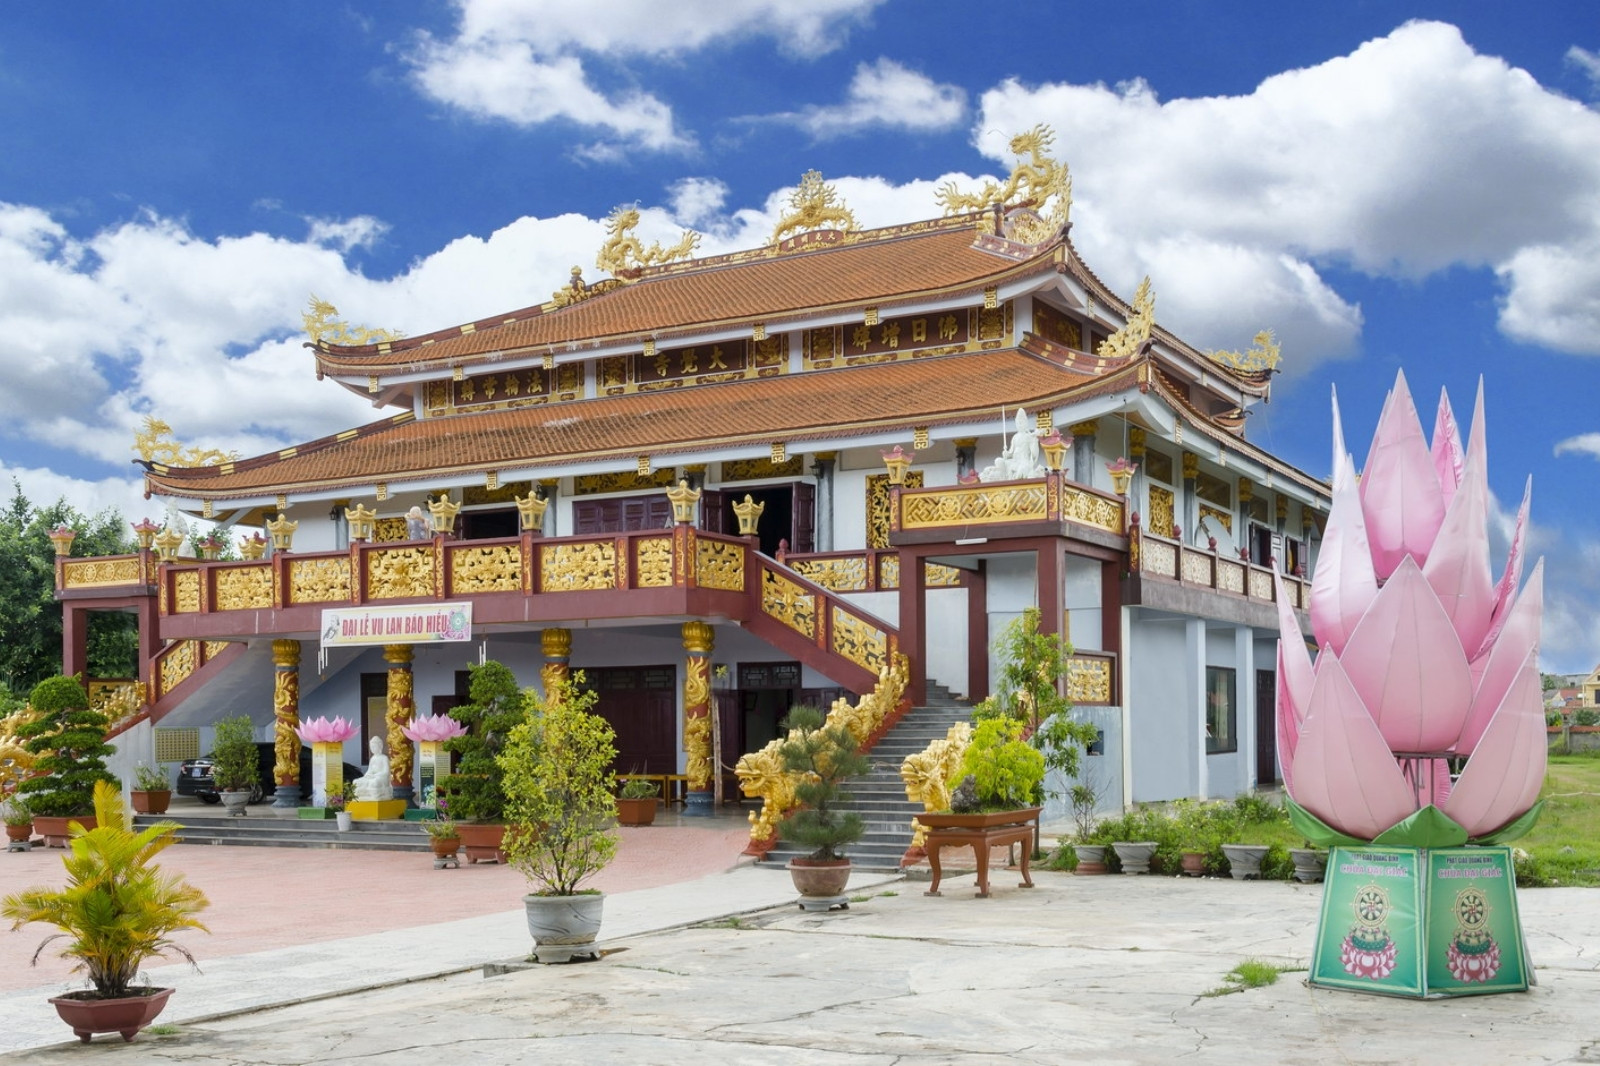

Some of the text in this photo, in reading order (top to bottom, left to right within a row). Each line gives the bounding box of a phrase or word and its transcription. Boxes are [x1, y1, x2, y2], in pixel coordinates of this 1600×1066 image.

[342, 619, 357, 639] ĐẠI
[372, 617, 384, 635] VU
[386, 617, 403, 635] LAN
[405, 613, 424, 634] BÁO
